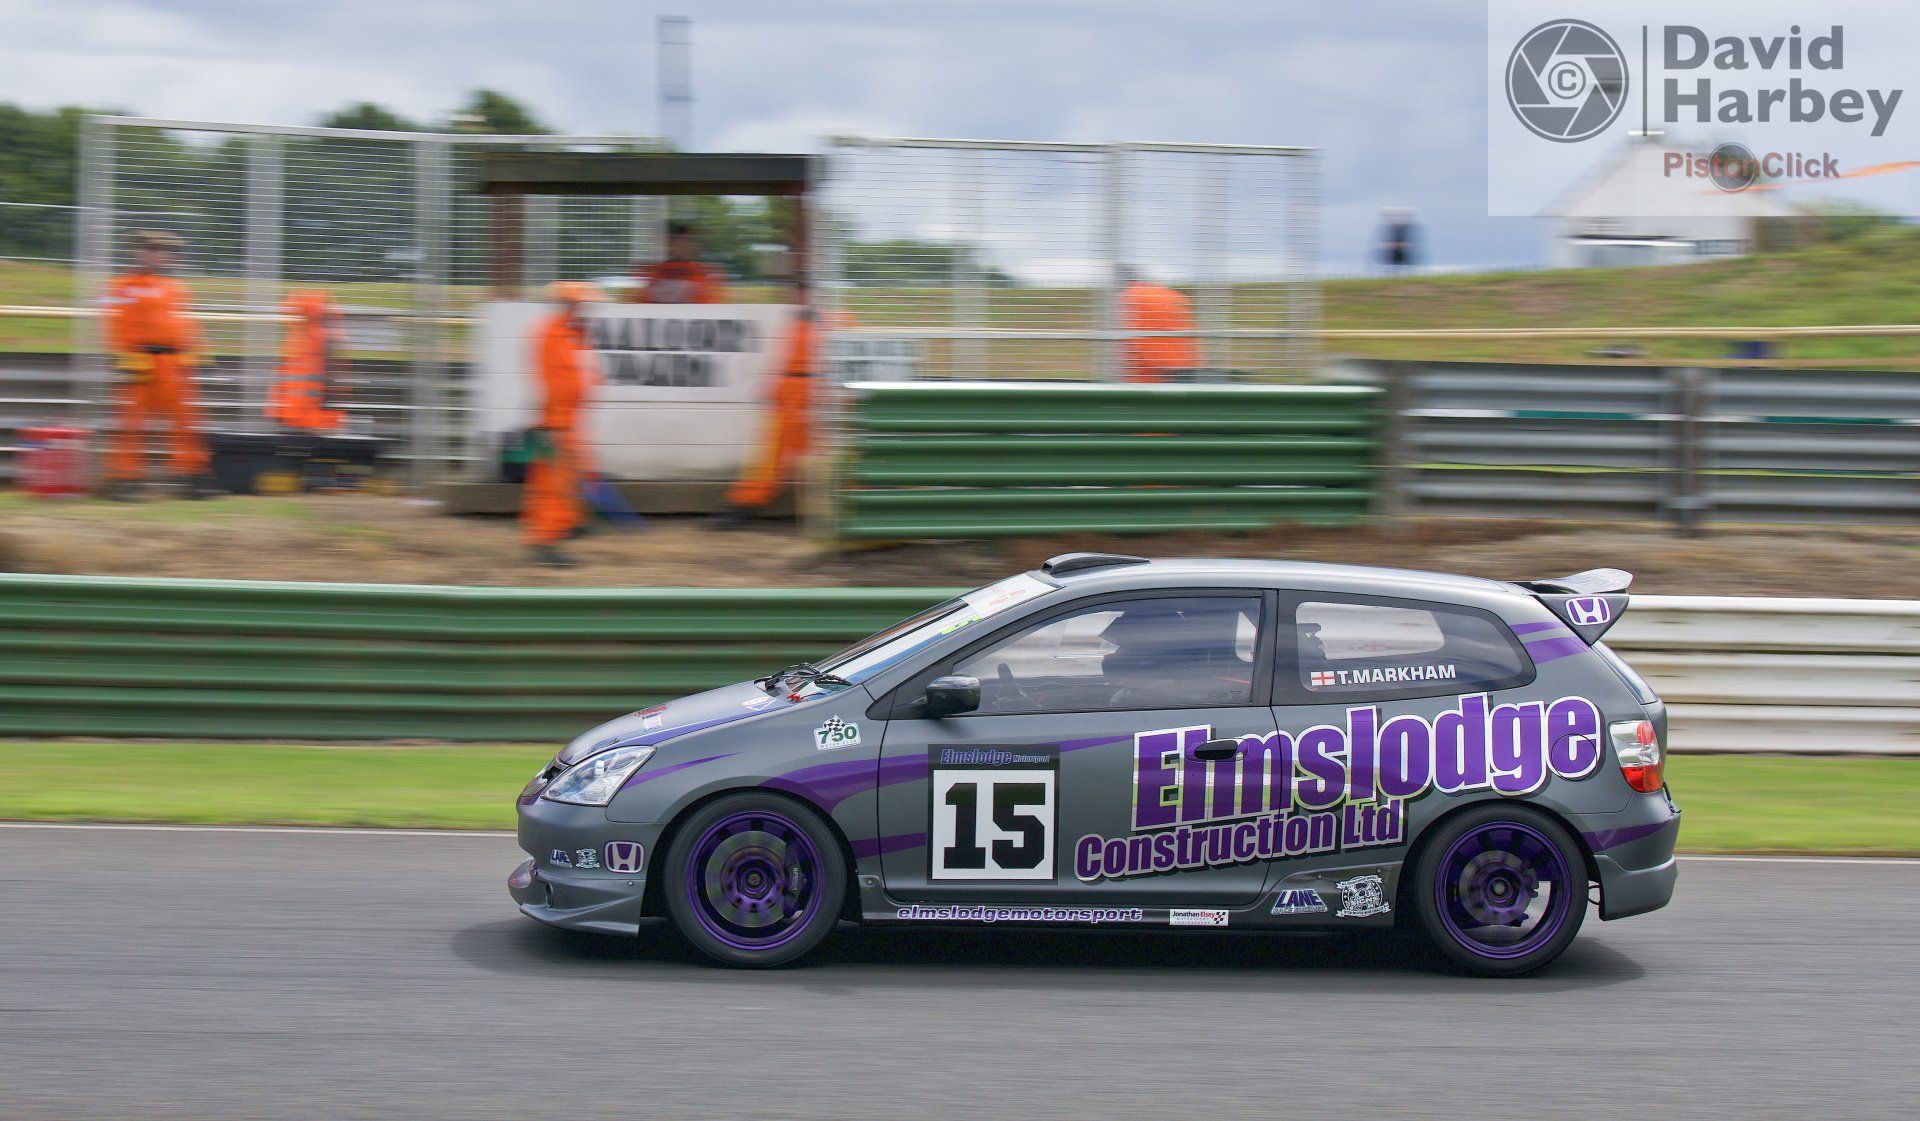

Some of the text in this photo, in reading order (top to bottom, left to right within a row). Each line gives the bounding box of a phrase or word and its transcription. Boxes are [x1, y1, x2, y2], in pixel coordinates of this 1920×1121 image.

[1337, 665, 1456, 685] T.MARKHAM
[818, 725, 857, 744] 750
[940, 748, 1012, 766] Elmslodge
[1132, 691, 1602, 833] Elmslodge
[943, 782, 1046, 869] 15
[1075, 797, 1404, 881] Construction Ltd
[1273, 888, 1325, 908] LANE
[896, 905, 1143, 924] elmslodgemotorsport
